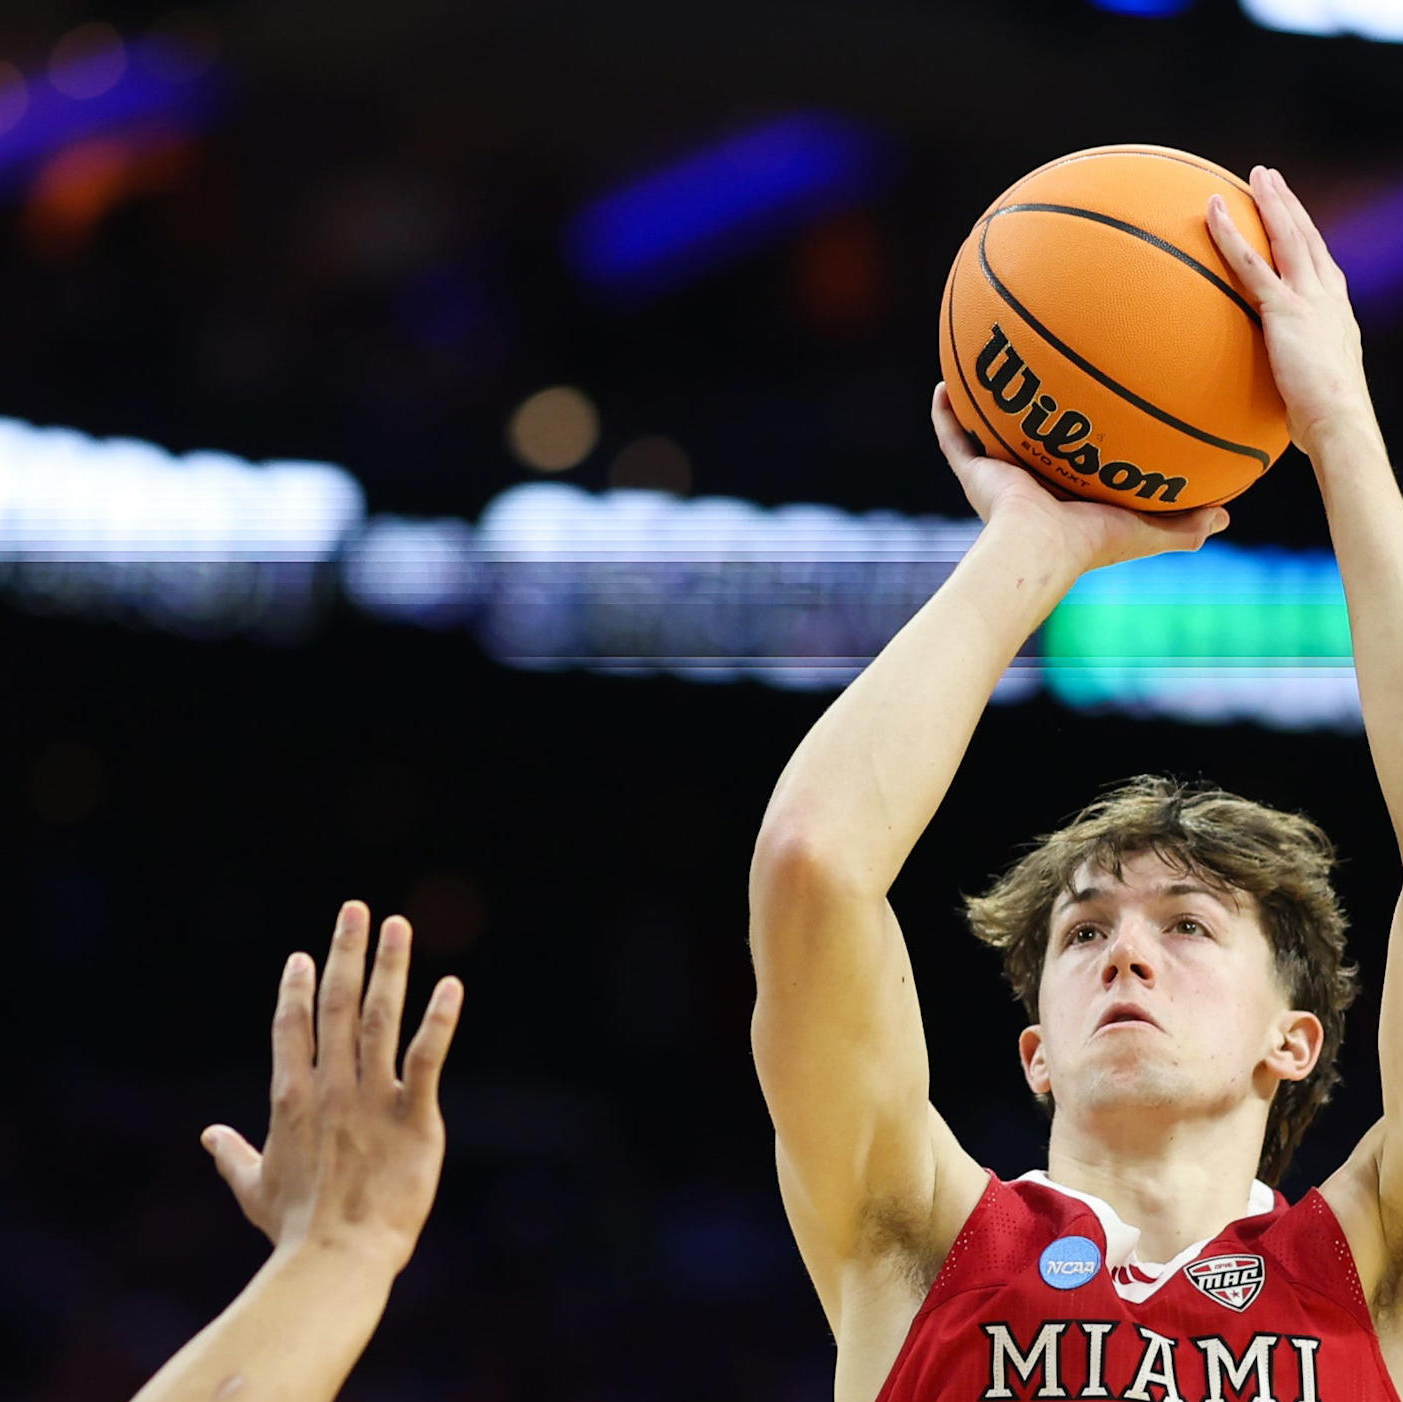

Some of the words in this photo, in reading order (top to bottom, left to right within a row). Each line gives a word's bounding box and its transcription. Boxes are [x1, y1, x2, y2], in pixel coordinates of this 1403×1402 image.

[975, 321, 1188, 503] Wilson
[1021, 440, 1052, 466] EVO
[1055, 466, 1090, 487] NXT
[1047, 1260, 1095, 1274] NCAA
[1197, 1268, 1262, 1291] MAC
